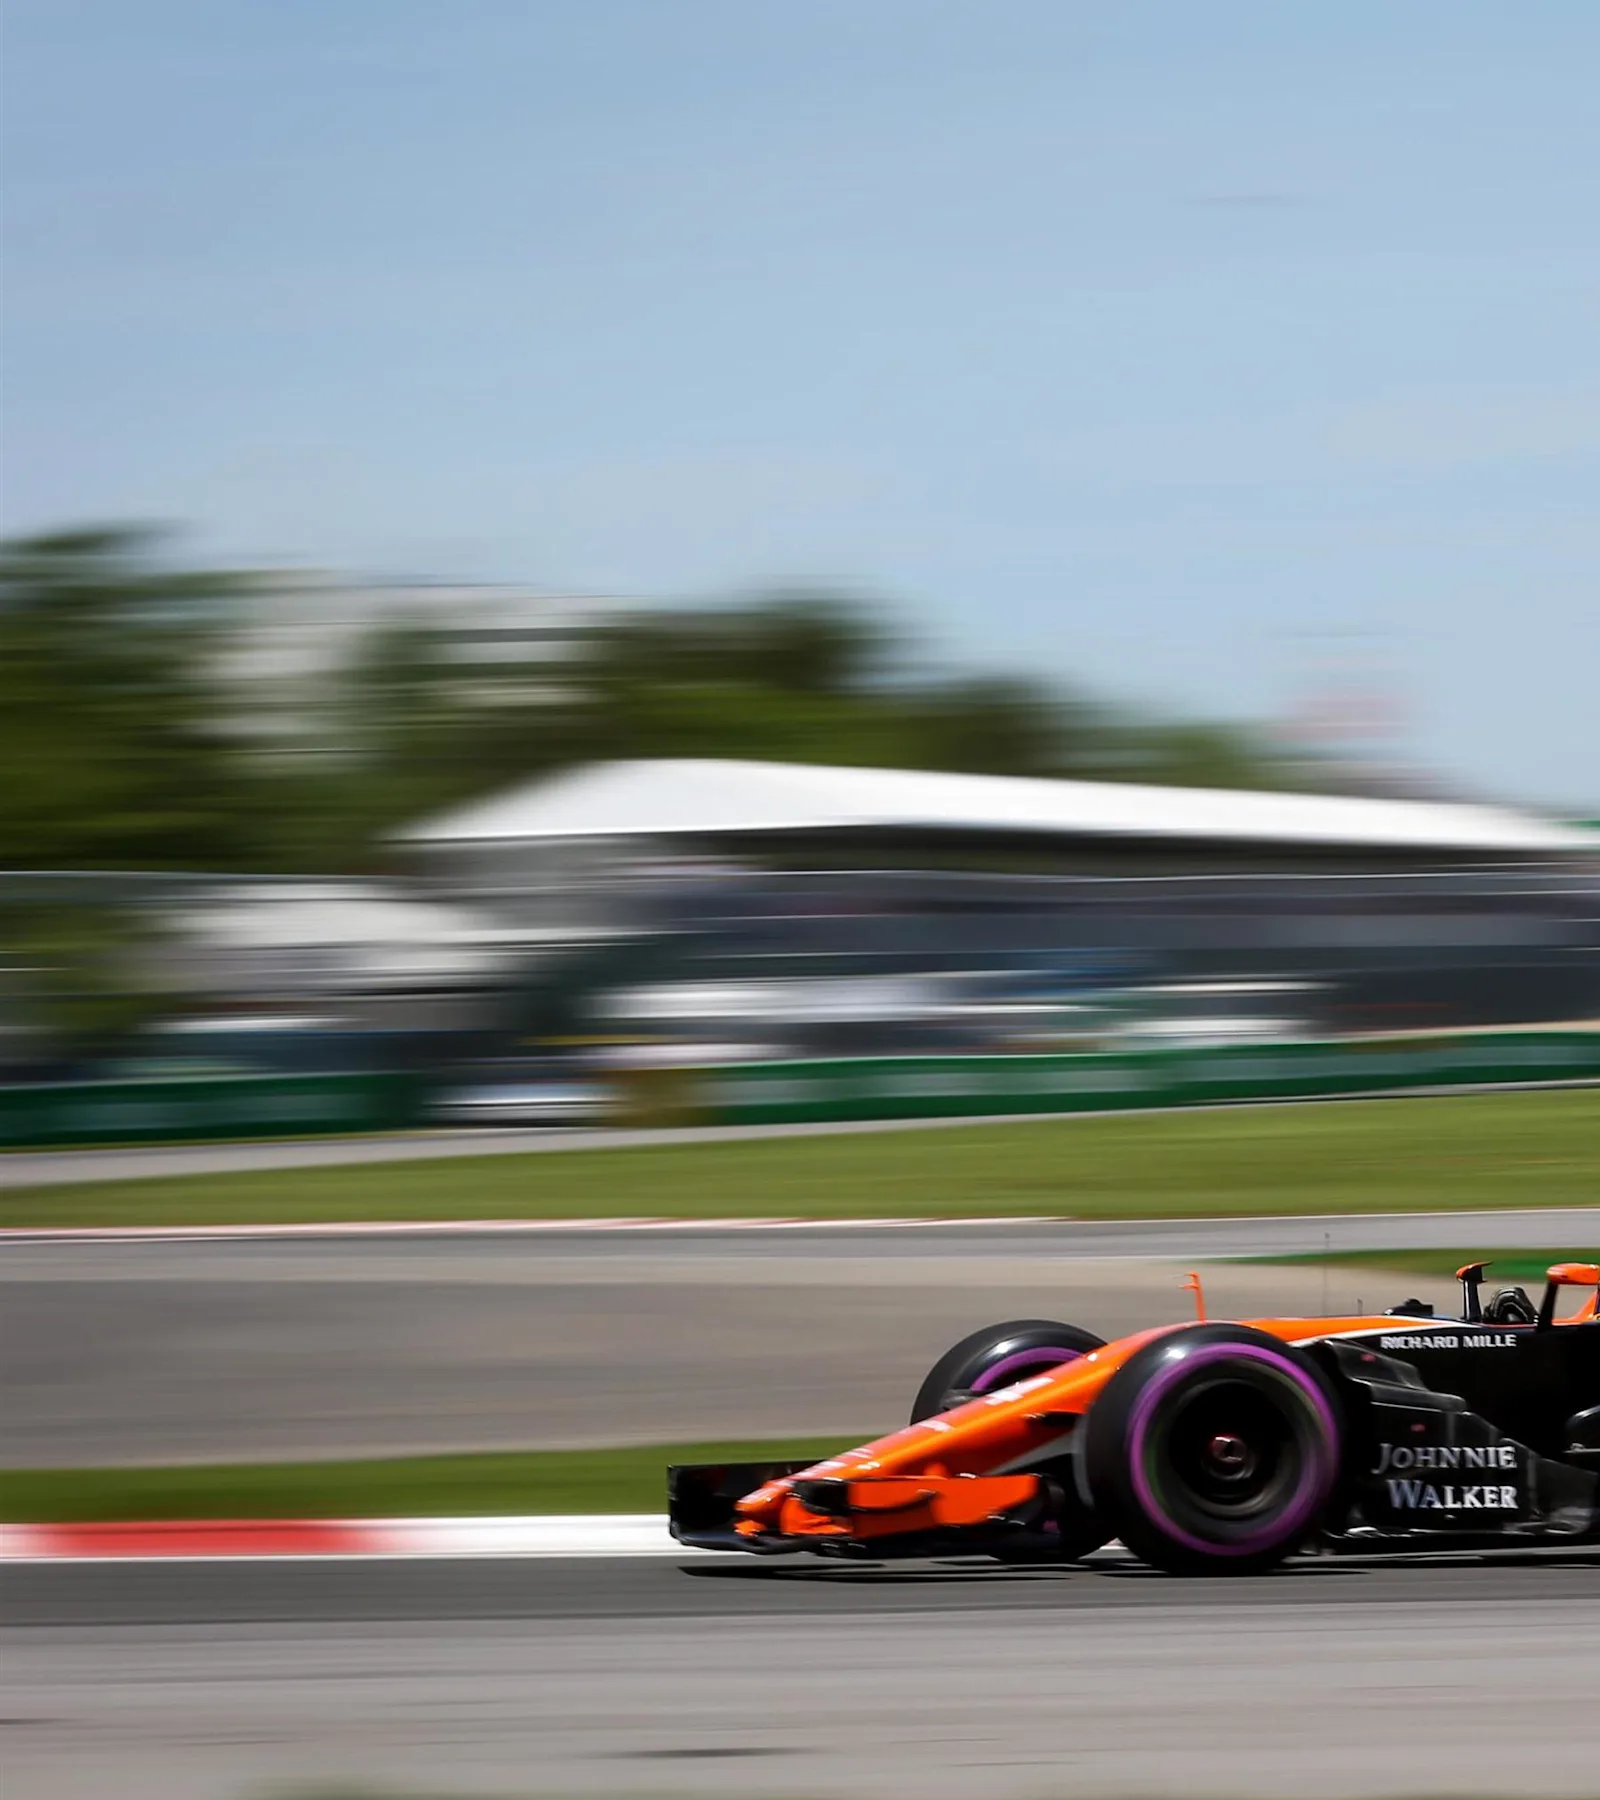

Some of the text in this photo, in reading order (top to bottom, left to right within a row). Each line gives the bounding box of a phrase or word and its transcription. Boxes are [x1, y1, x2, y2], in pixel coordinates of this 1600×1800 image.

[1380, 1333, 1517, 1349] RICHARD MILLE
[1370, 1443, 1517, 1474] JOHNNIE
[1386, 1478, 1519, 1509] WALKER
